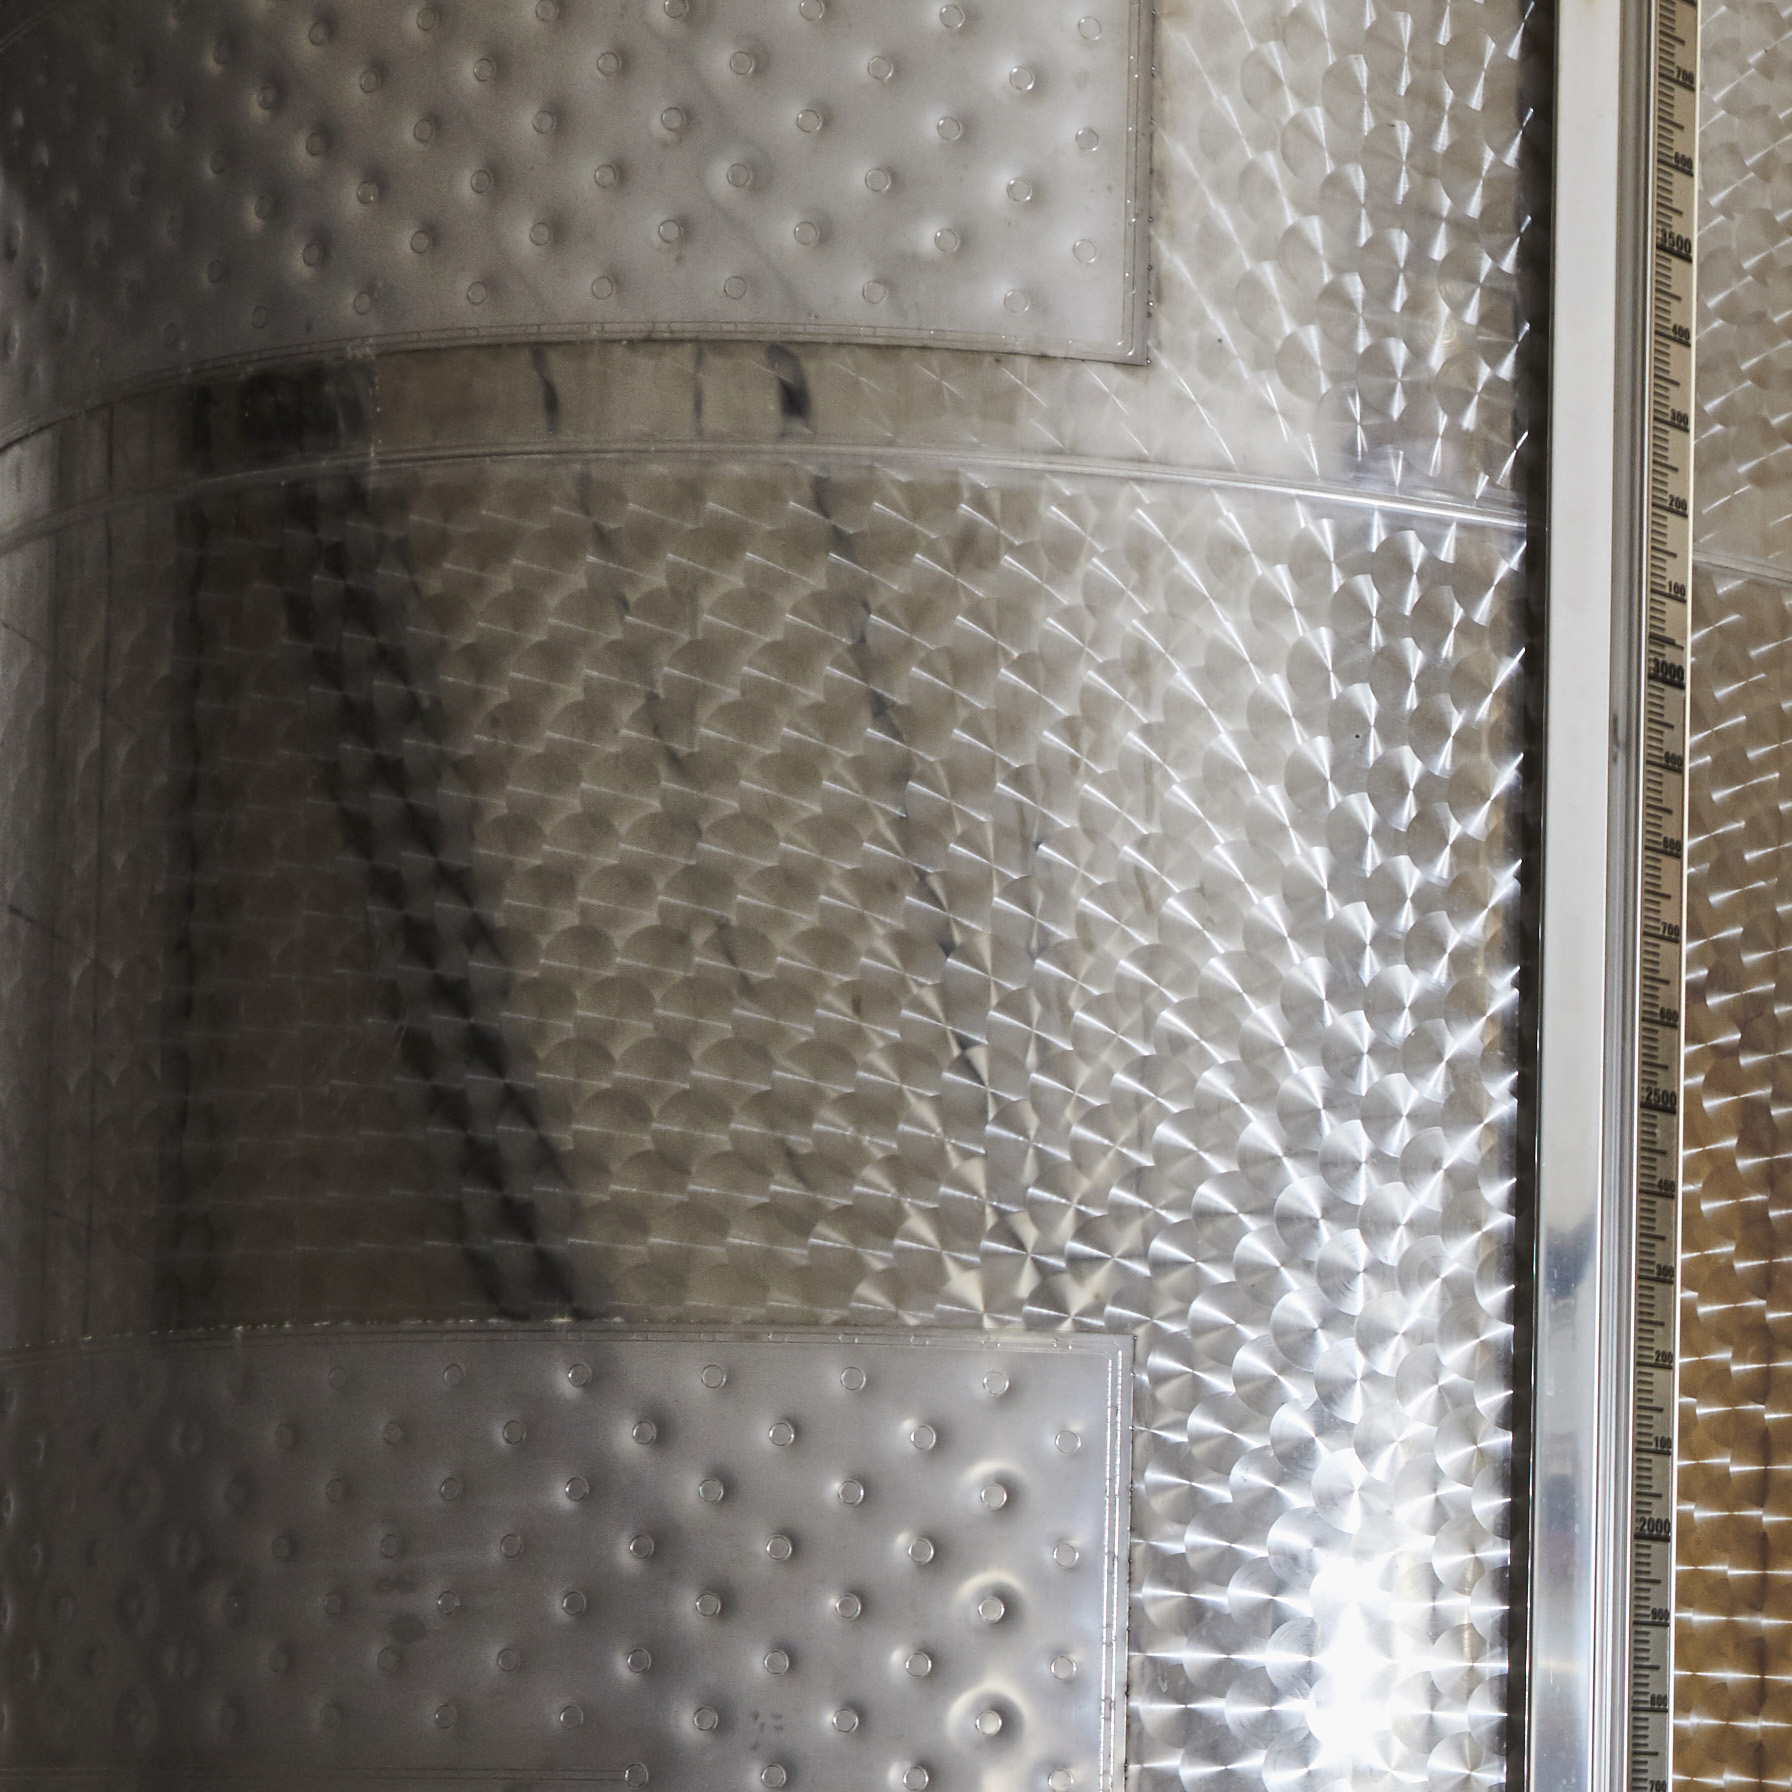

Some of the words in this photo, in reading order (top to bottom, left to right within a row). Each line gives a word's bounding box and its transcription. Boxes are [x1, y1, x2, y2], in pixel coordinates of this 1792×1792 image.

[1675, 66, 1694, 84] 700
[1659, 229, 1692, 254] 3500
[1672, 324, 1690, 340] 400
[1670, 409, 1689, 426] 300
[1669, 495, 1688, 511] 200
[1668, 580, 1686, 597] 100
[1653, 662, 1684, 682] 3000
[1664, 751, 1683, 768] 900
[1662, 922, 1680, 938] 700
[1660, 1008, 1678, 1024] 600
[1646, 1089, 1677, 1107] 2500
[1658, 1179, 1676, 1194] 400
[1656, 1264, 1674, 1279] 300
[1655, 1350, 1674, 1365] 200
[1654, 1436, 1672, 1449] 100
[1639, 1516, 1671, 1534] 2000
[1651, 1608, 1670, 1622] 900
[1650, 1694, 1668, 1707] 800
[1649, 1780, 1667, 1792] 700
